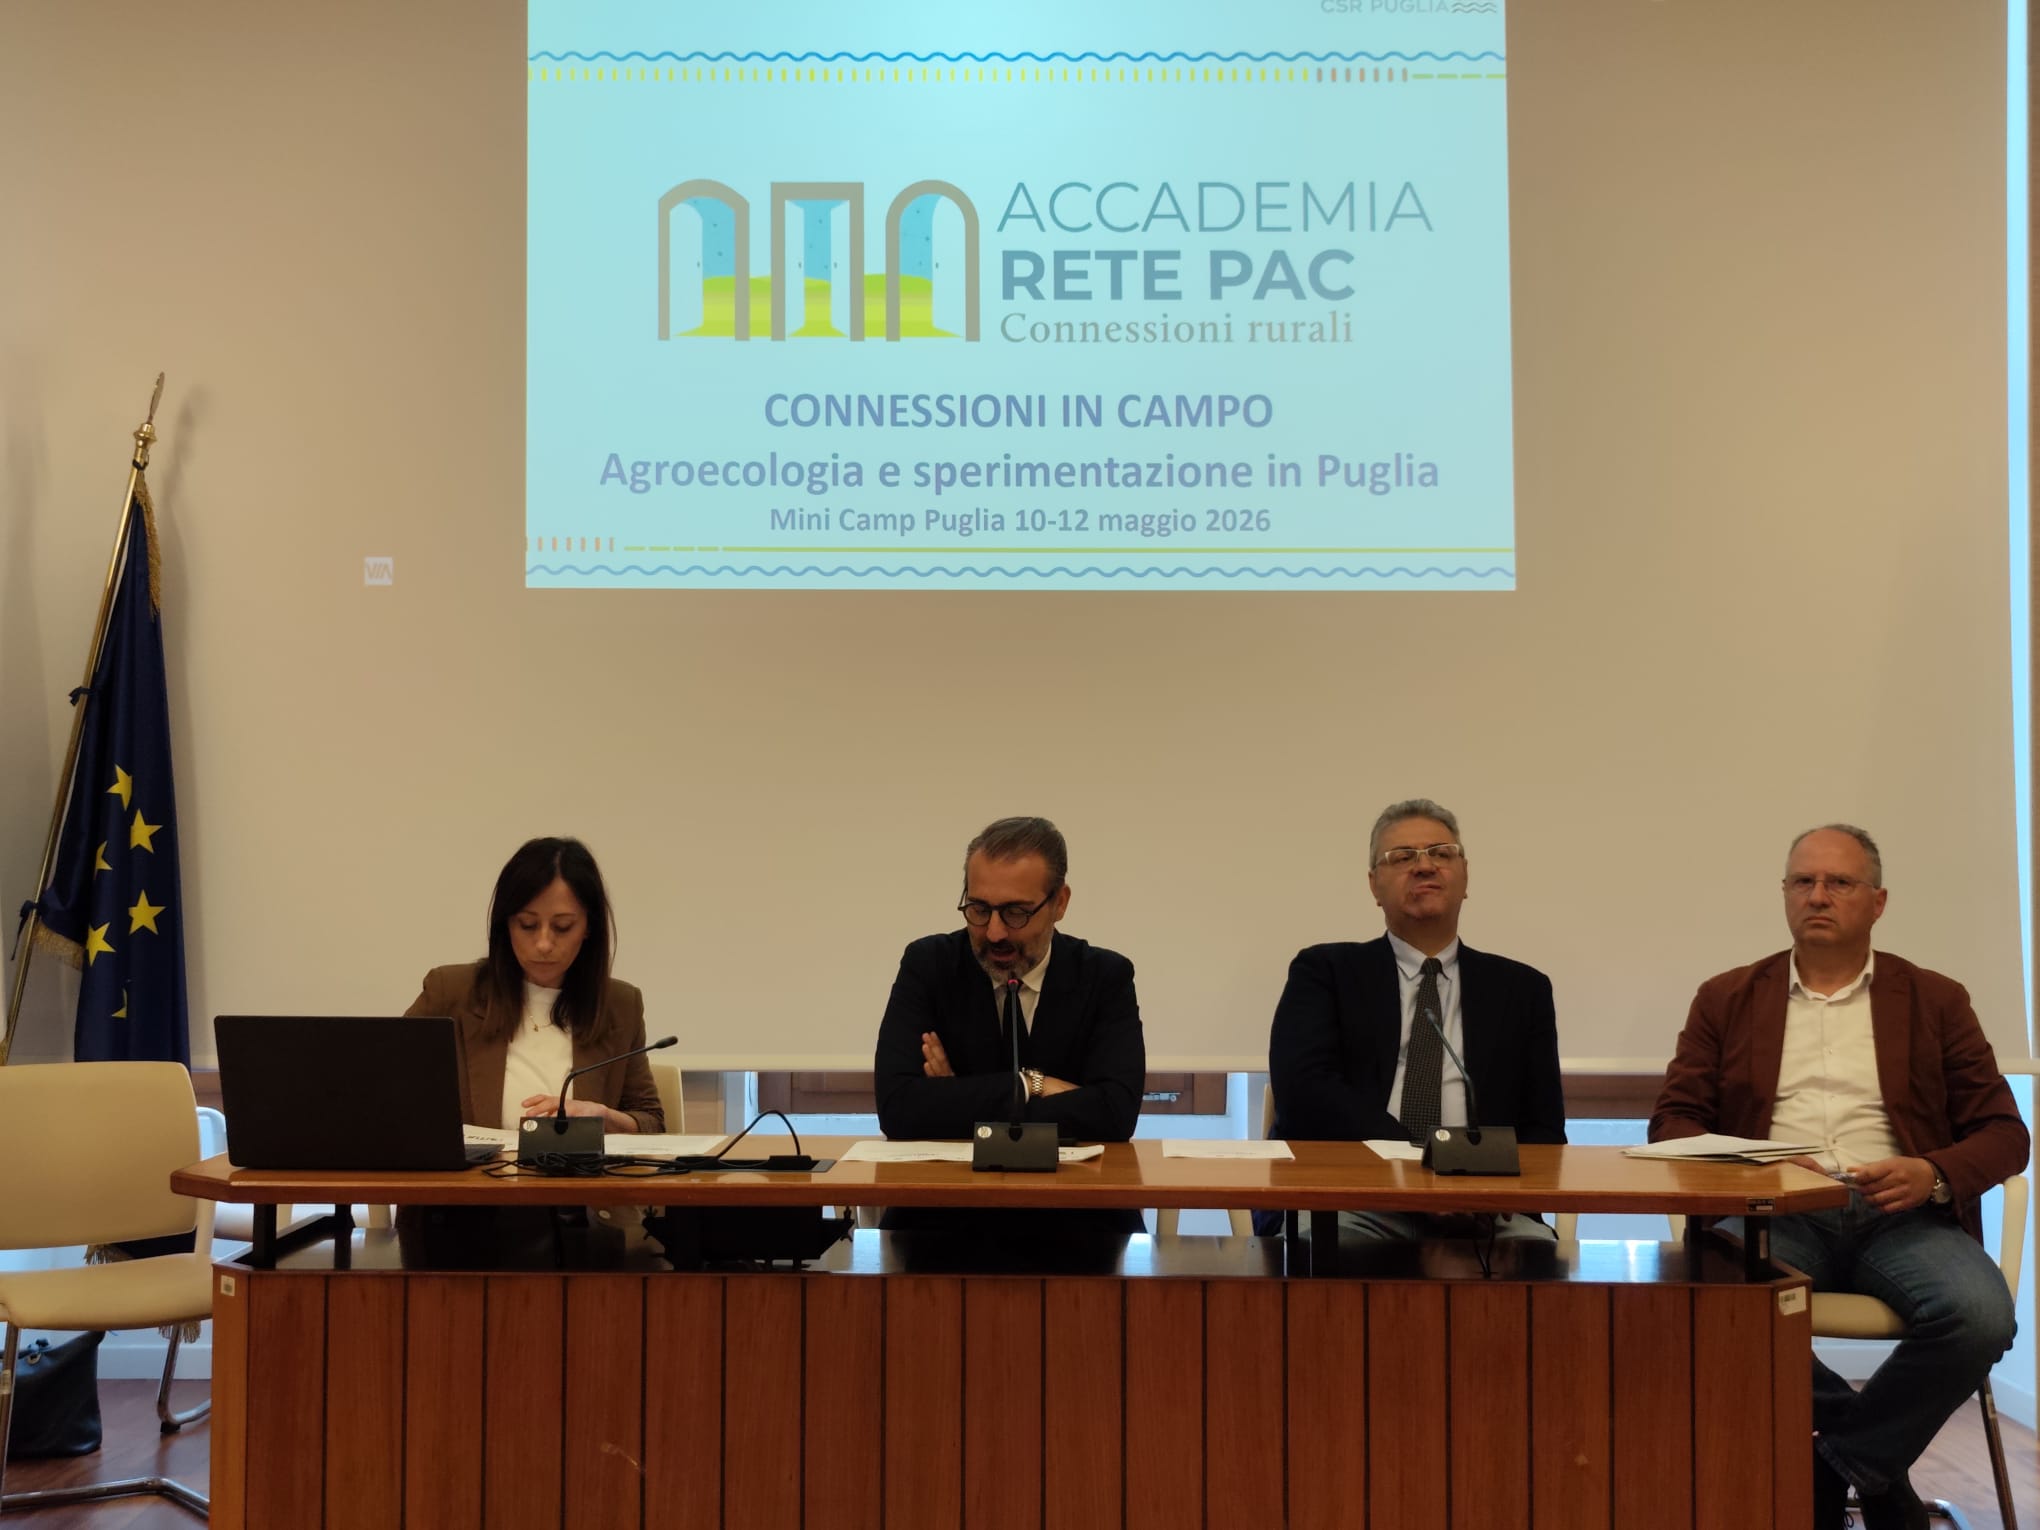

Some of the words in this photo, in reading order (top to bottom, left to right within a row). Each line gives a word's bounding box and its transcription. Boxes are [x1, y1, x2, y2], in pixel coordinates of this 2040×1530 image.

[1321, 0, 1363, 13] CSR
[1371, 0, 1449, 13] PUGLIA
[997, 181, 1433, 233] ACCADEMIA
[1001, 249, 1183, 301] RETE
[1209, 248, 1356, 301] PAC
[1000, 312, 1233, 343] Connessioni
[1248, 311, 1353, 343] rurali
[764, 393, 1046, 428] CONNESSIONI
[1062, 394, 1103, 428] IN
[1117, 393, 1274, 429] CAMPO
[600, 452, 864, 496] Agroecologia
[878, 461, 901, 488] e
[913, 453, 1253, 496] sperimentazione
[1267, 453, 1302, 488] in
[1318, 453, 1439, 496] Puglia
[770, 507, 830, 531] Mini
[838, 508, 916, 537] Camp
[925, 507, 1005, 538] Puglia
[1015, 508, 1090, 532] 10-12
[1098, 508, 1197, 538] maggio
[1206, 508, 1271, 532] 2026
